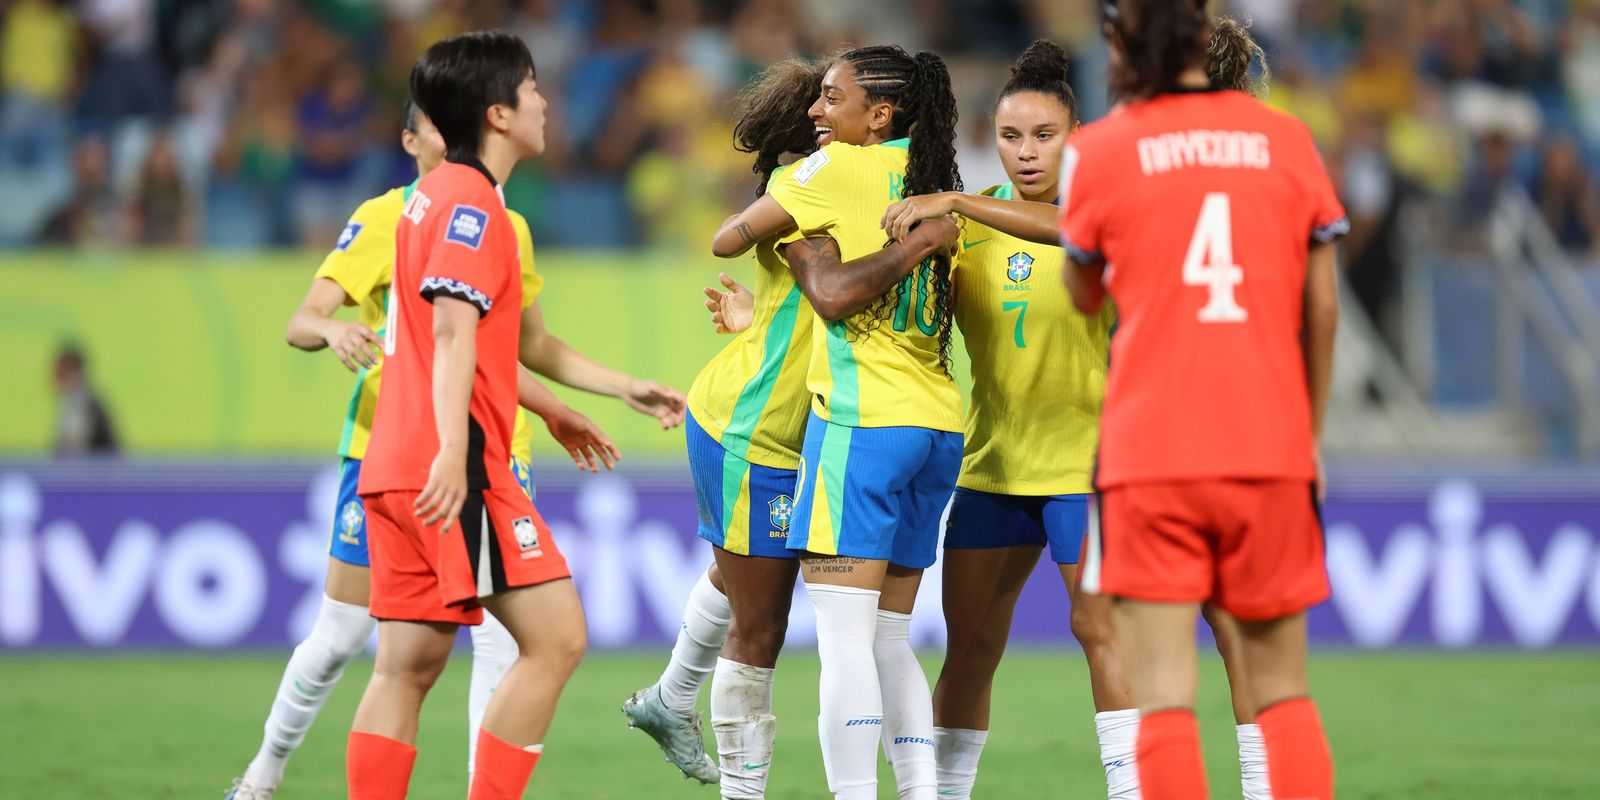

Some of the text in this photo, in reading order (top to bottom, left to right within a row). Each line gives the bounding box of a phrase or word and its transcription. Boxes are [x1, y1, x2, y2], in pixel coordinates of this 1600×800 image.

[1182, 192, 1248, 322] 4
[1002, 301, 1029, 348] 7
[1324, 478, 1600, 648] viv
